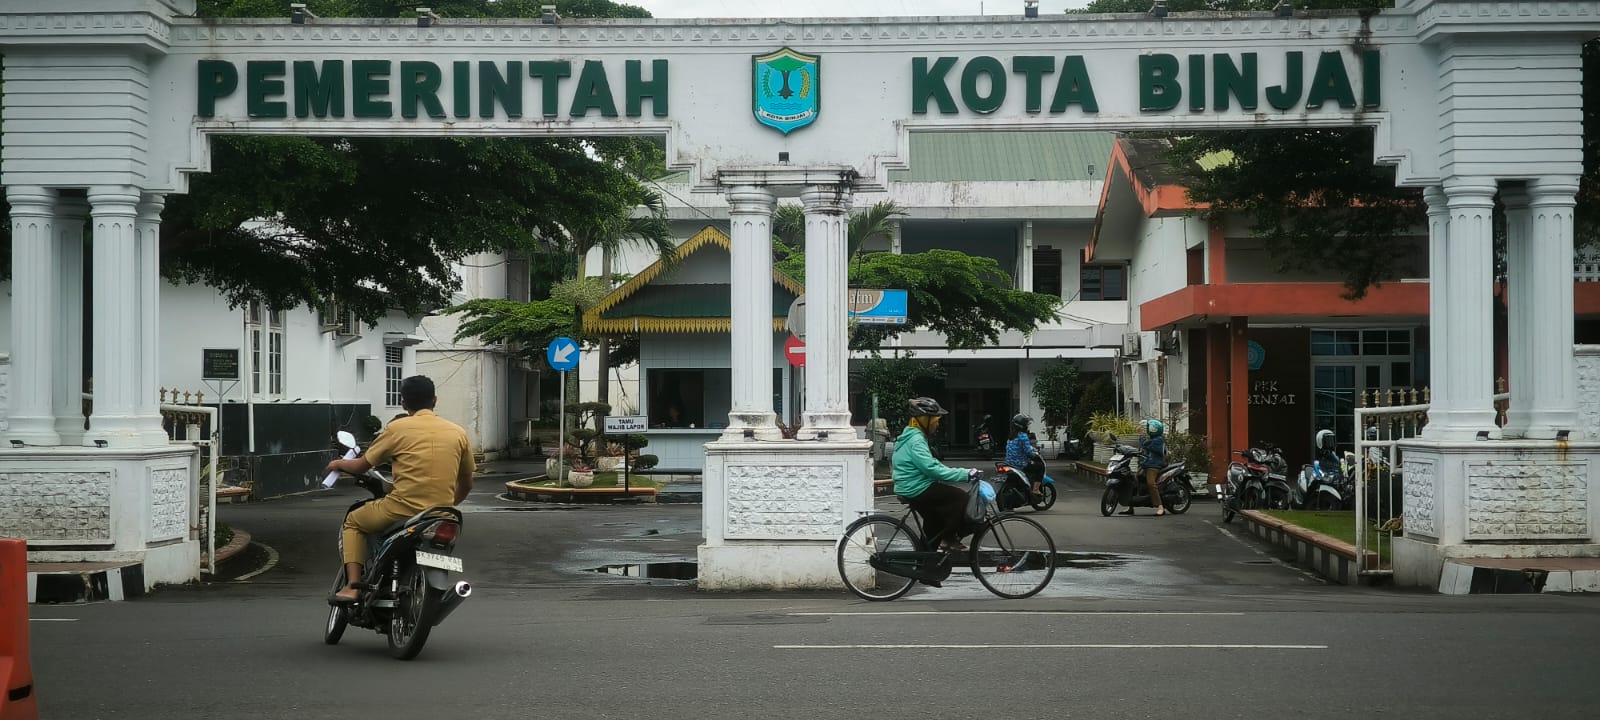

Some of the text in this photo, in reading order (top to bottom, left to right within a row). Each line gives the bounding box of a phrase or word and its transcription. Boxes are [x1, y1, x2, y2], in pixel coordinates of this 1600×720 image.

[197, 49, 1382, 118] PEMERINTAH KOTA BINJAI
[766, 112, 806, 121] KOTA BINJAI
